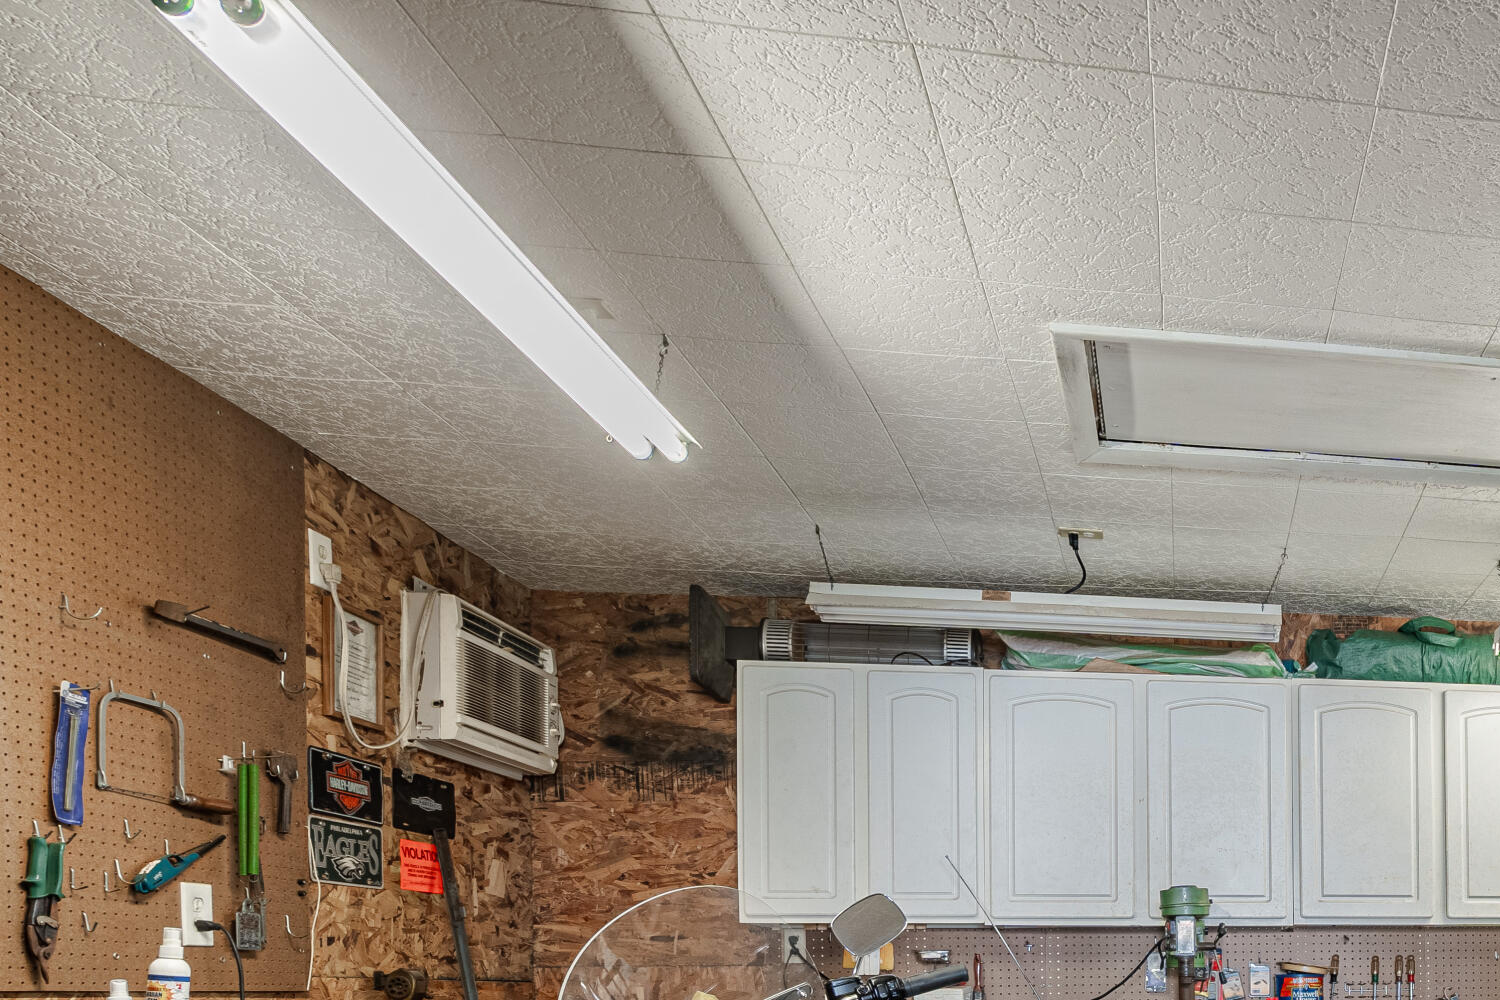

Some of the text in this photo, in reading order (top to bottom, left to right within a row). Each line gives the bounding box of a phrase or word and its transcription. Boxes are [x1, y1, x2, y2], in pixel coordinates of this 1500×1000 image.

[330, 824, 363, 836] PHILADELPHIA
[312, 824, 379, 876] EAGLES
[1292, 989, 1319, 998] Maxwell
